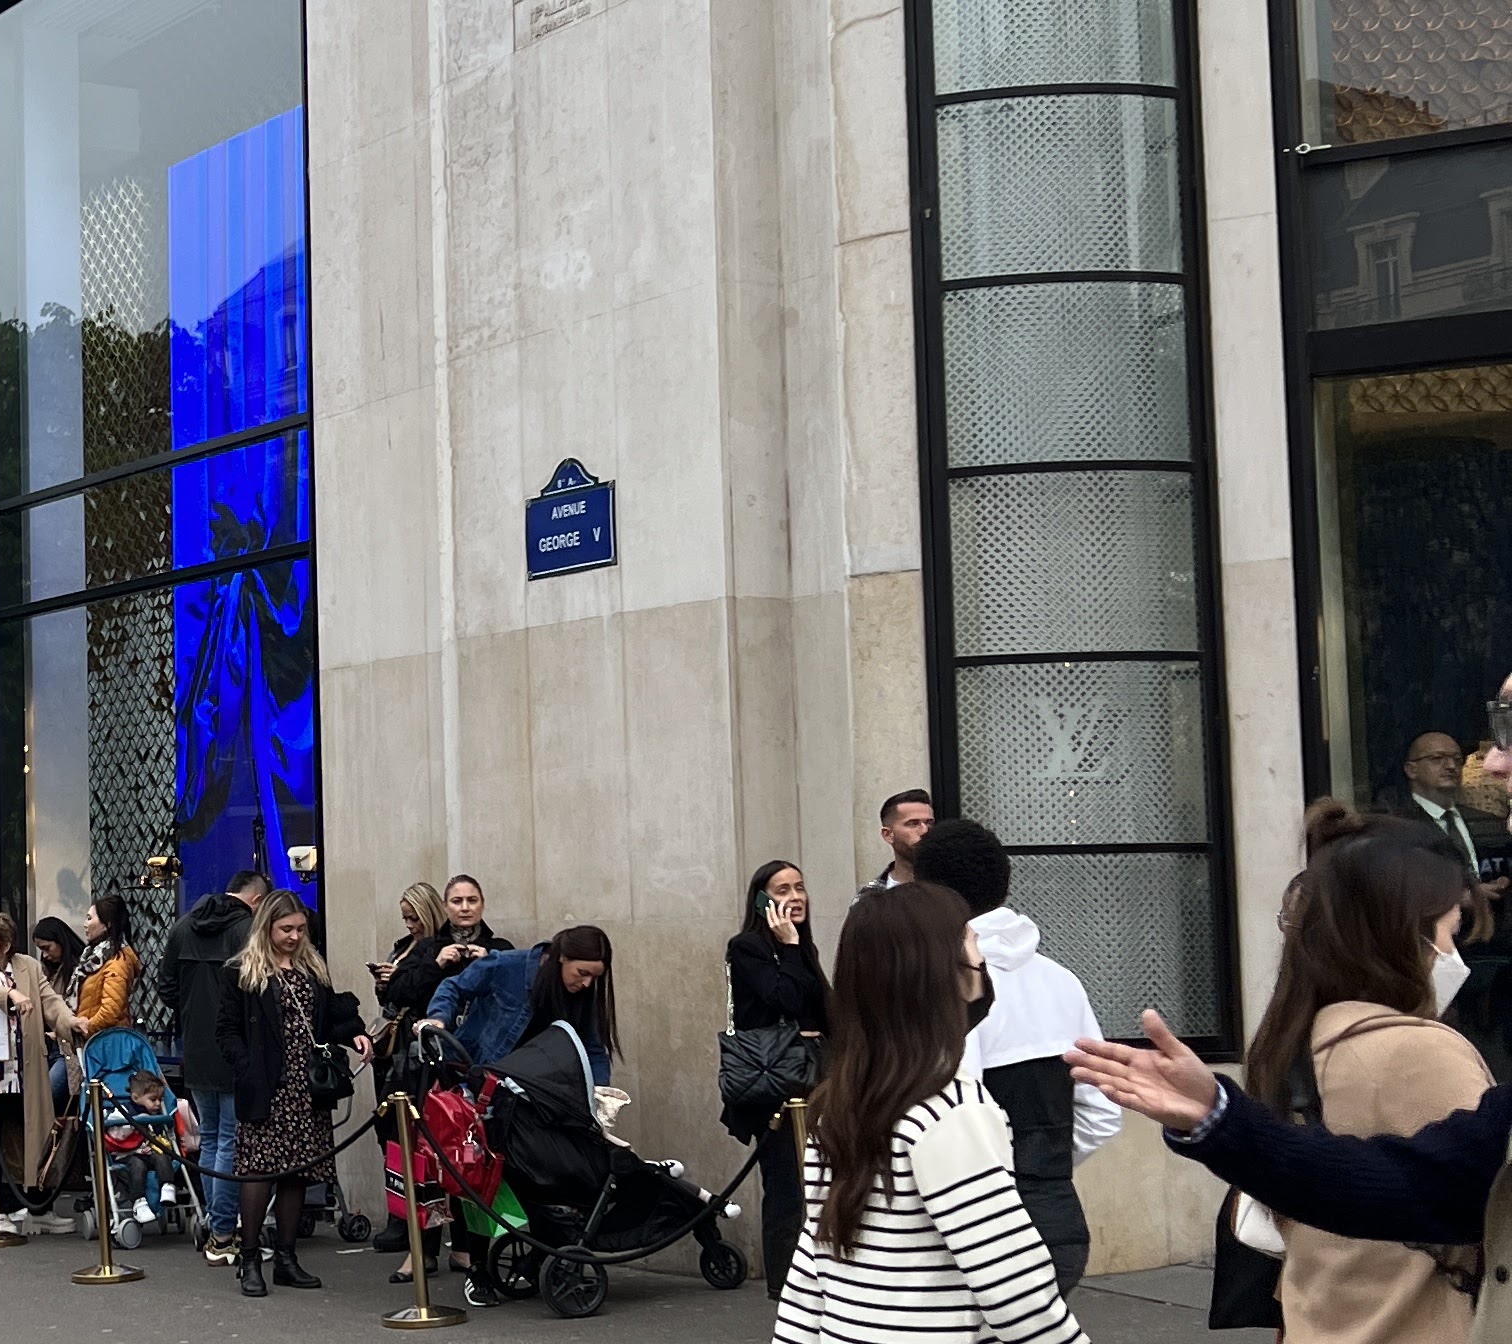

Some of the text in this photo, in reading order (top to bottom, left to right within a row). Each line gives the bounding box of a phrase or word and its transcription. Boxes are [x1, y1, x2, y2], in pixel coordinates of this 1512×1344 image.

[551, 500, 587, 520] AVENUE
[539, 526, 601, 553] GEORGE V
